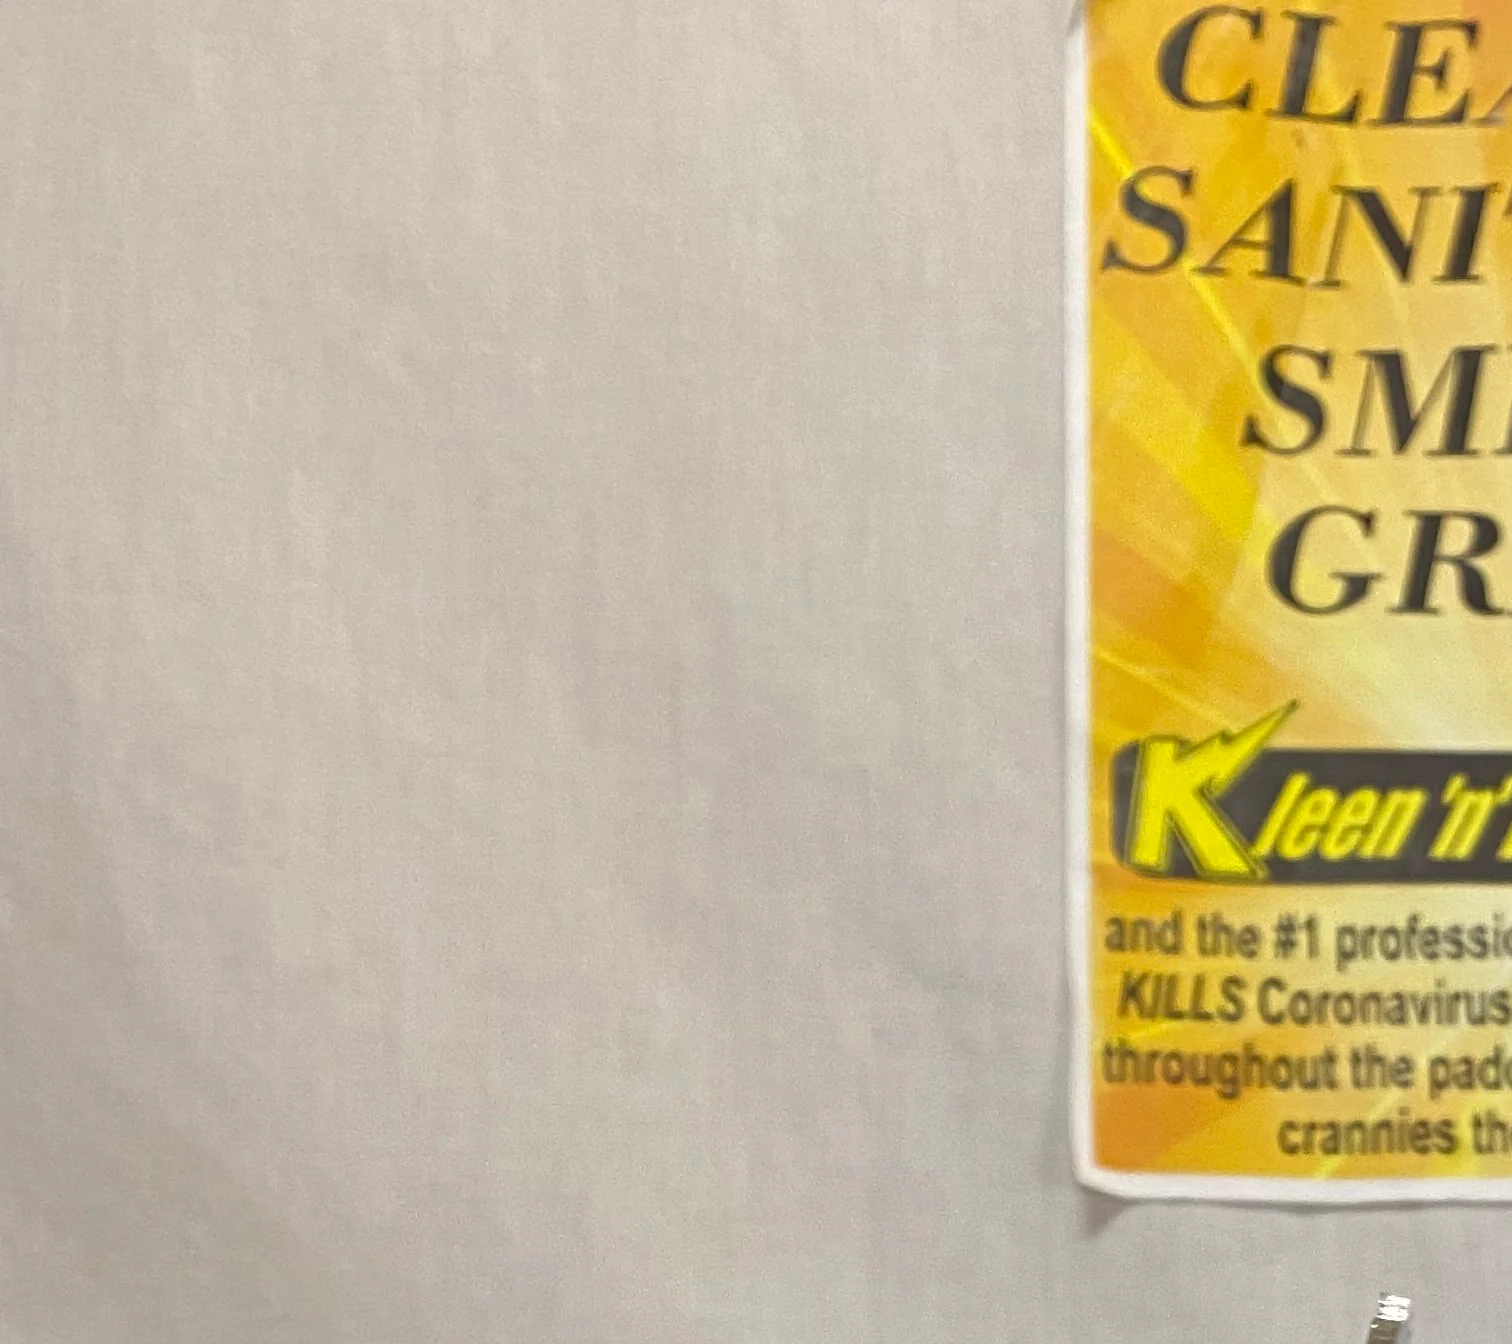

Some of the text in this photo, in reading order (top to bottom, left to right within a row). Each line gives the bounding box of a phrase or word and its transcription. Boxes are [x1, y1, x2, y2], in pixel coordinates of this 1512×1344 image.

[1105, 908, 1183, 955] and
[1198, 913, 1258, 958] the
[1273, 914, 1320, 960] #1
[1119, 970, 1245, 1022] KILLS
[1102, 1036, 1338, 1100] throughout
[1350, 1043, 1414, 1089] the
[1278, 1107, 1458, 1156] crannies
